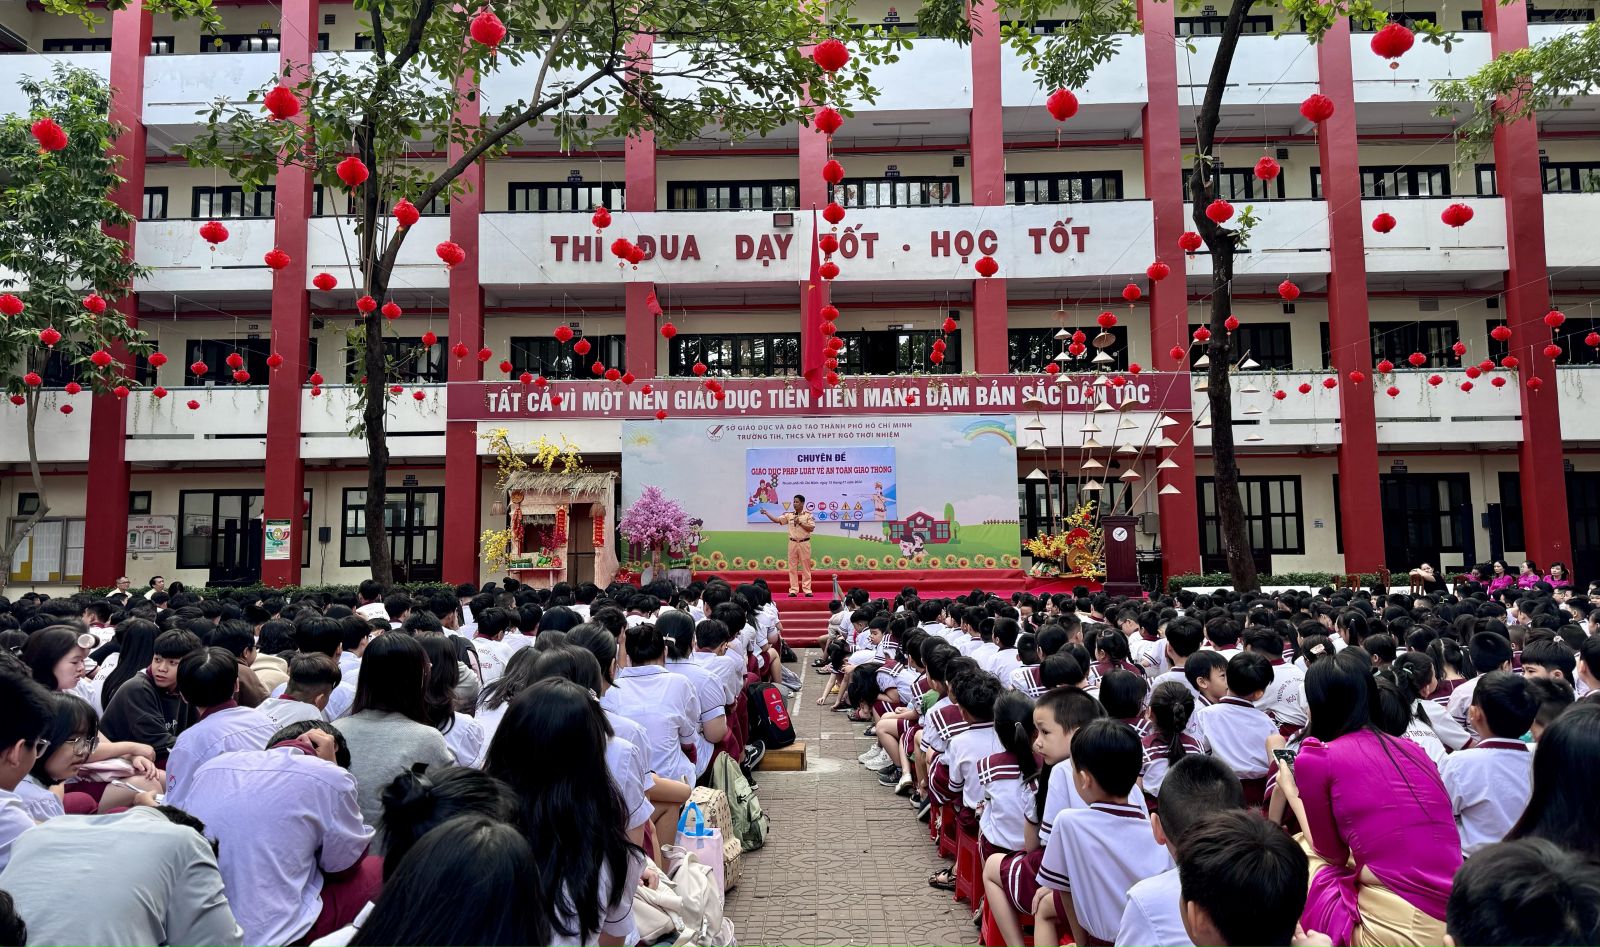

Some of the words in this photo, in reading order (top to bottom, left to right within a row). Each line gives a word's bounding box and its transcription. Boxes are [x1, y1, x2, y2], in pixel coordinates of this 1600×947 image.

[551, 235, 602, 262] THI
[635, 234, 701, 261] ĐUA
[735, 233, 793, 267] DẠY
[930, 229, 998, 264] HỌC
[1029, 217, 1090, 255] TỐT
[487, 385, 522, 412] TẤT
[527, 385, 553, 412] CẢ
[558, 387, 576, 411] VÌ
[582, 387, 624, 415] MỘT
[674, 385, 718, 410] GIÁO
[724, 389, 762, 413] DỤC
[768, 384, 810, 409] TIÊN
[863, 387, 920, 407] MANG
[926, 382, 970, 411] ĐẬM
[976, 379, 1016, 406] BẢN
[1021, 378, 1061, 405] SẮC
[1066, 380, 1108, 405] DÂN
[838, 431, 854, 439] NGÔ
[797, 452, 833, 463] CHUYÊN
[825, 466, 835, 474] AN
[853, 465, 870, 474] GIAO
[870, 464, 893, 474] THÔNG
